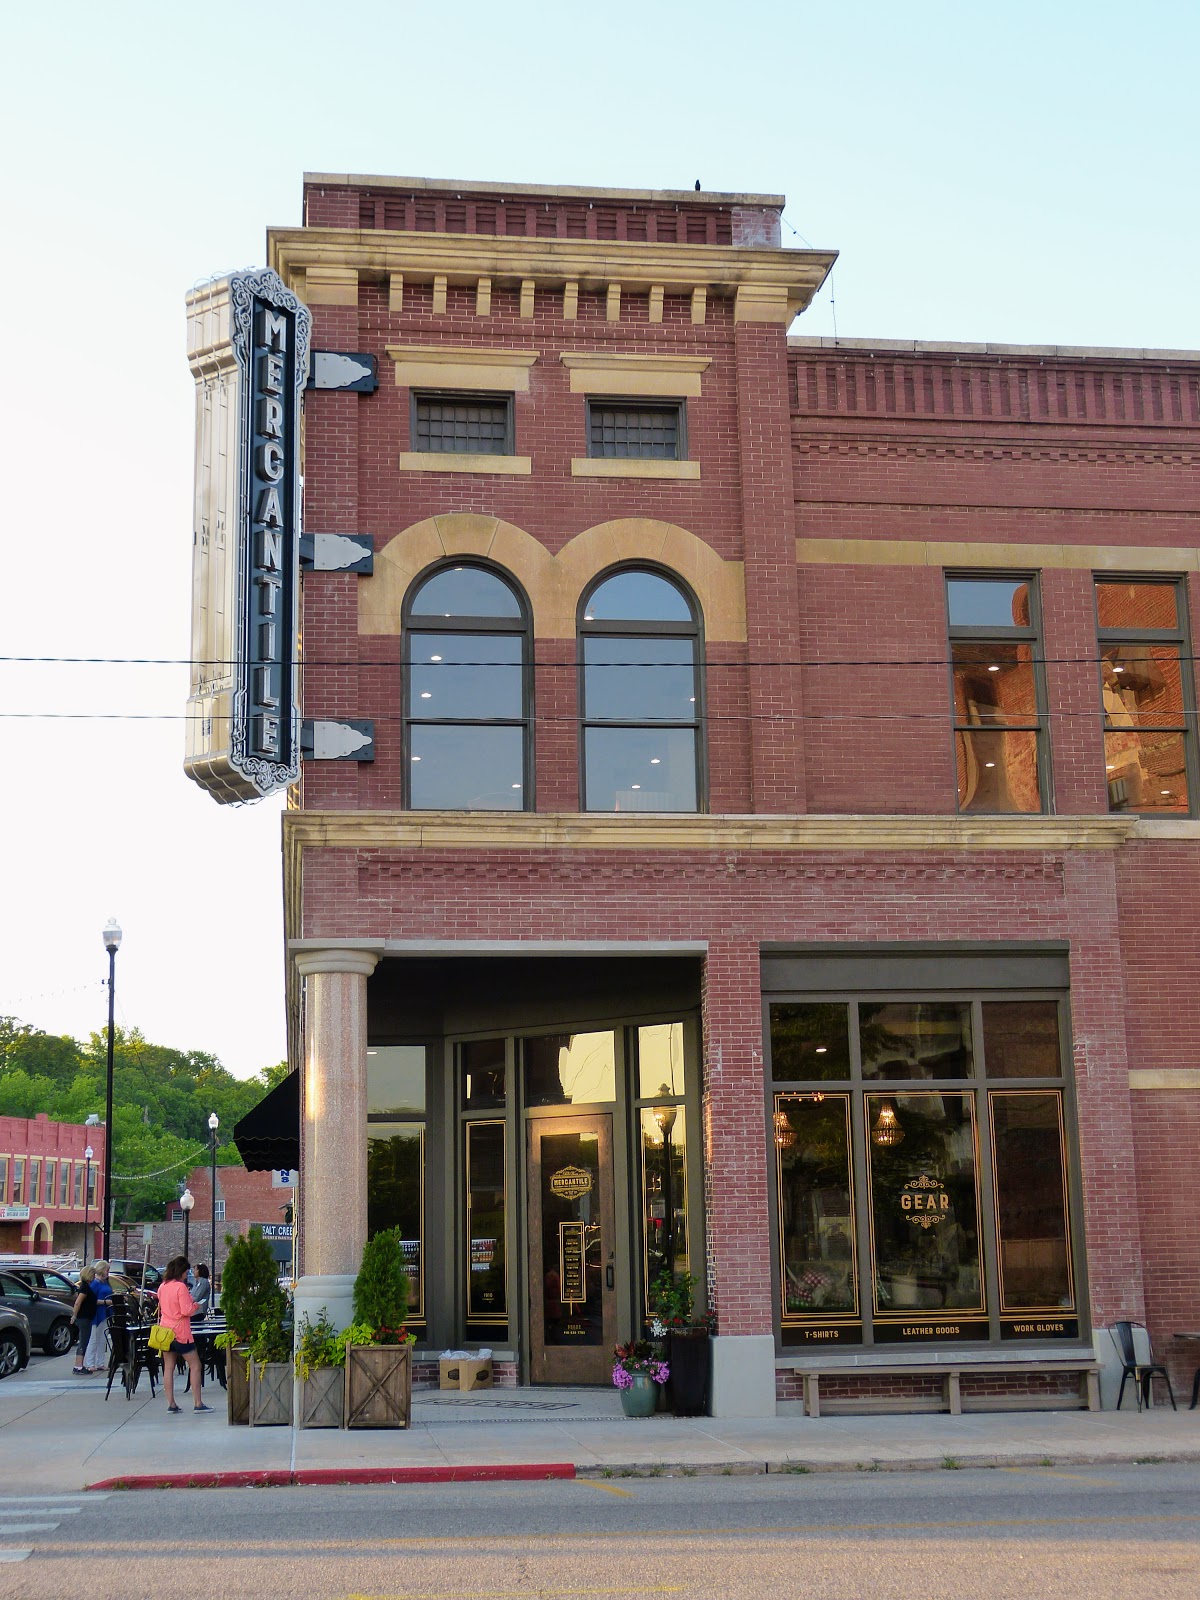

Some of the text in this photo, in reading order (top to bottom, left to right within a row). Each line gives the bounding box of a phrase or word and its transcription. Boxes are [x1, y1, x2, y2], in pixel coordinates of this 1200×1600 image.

[257, 309, 287, 757] MERCANTILE
[553, 1178, 588, 1186] MERCANTILE
[901, 1194, 949, 1210] GEAR
[902, 1326, 960, 1335] LEATHER GOODS
[1013, 1323, 1064, 1333] WORK GLOVES
[804, 1330, 839, 1339] T-SHIRTS
